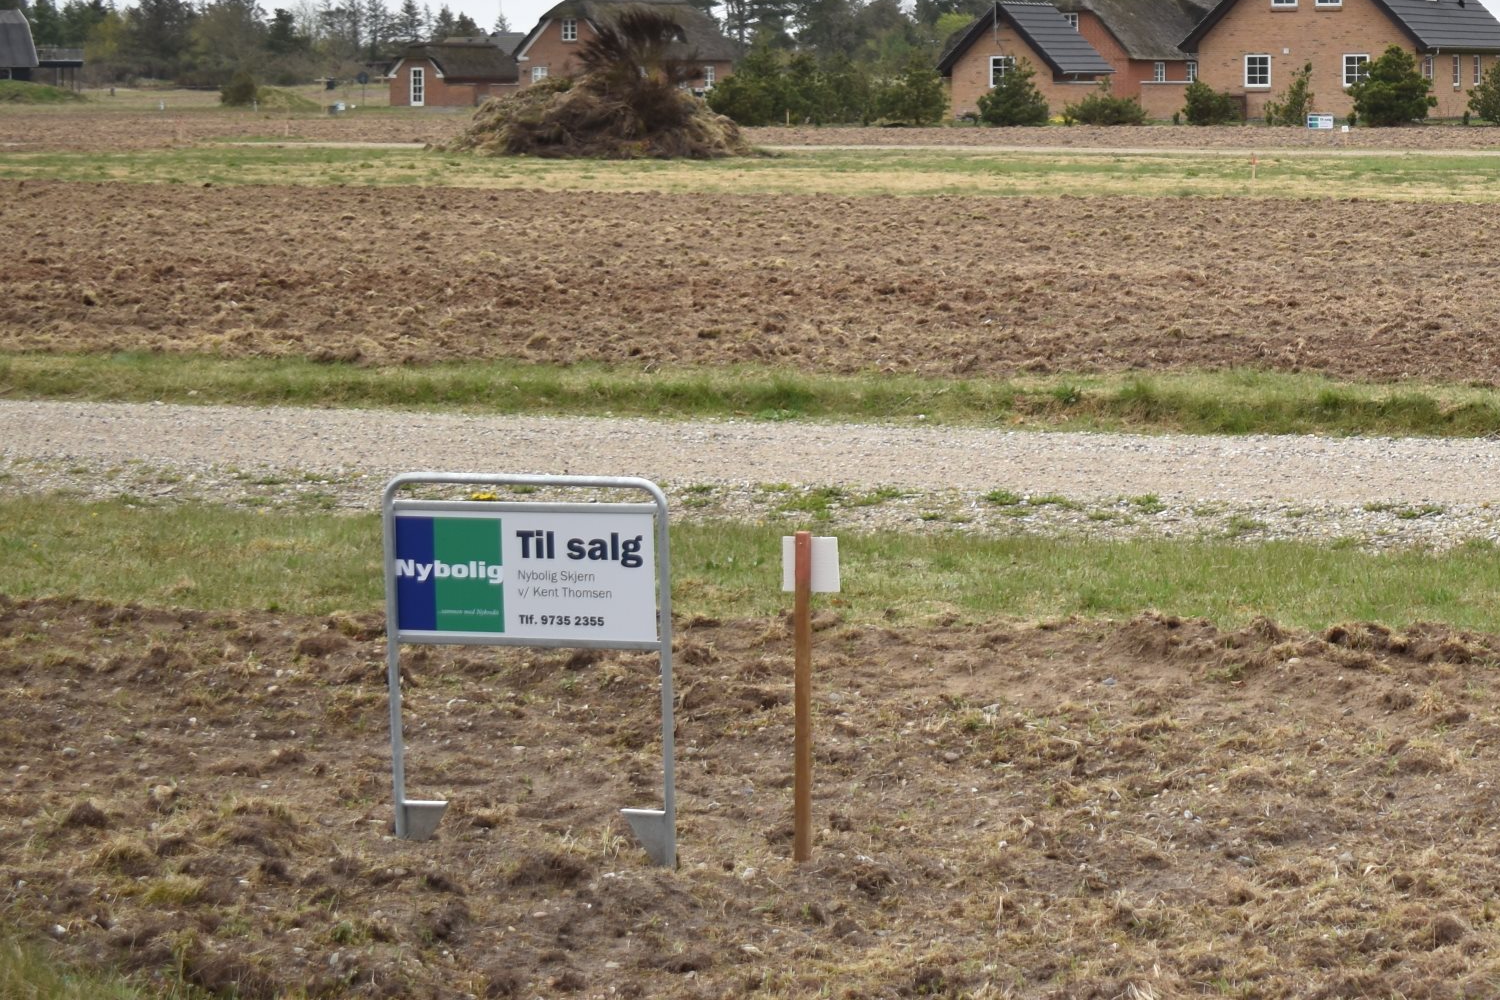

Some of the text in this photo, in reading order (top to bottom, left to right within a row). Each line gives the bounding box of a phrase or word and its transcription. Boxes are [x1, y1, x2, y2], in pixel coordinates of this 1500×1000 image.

[516, 529, 644, 569] Til salg
[395, 558, 504, 584] Nybolig
[517, 569, 596, 584] Nybolig Skjern
[517, 586, 613, 599] v/ Kent Thomsen
[518, 614, 605, 627] Tlf. 9735 2355
